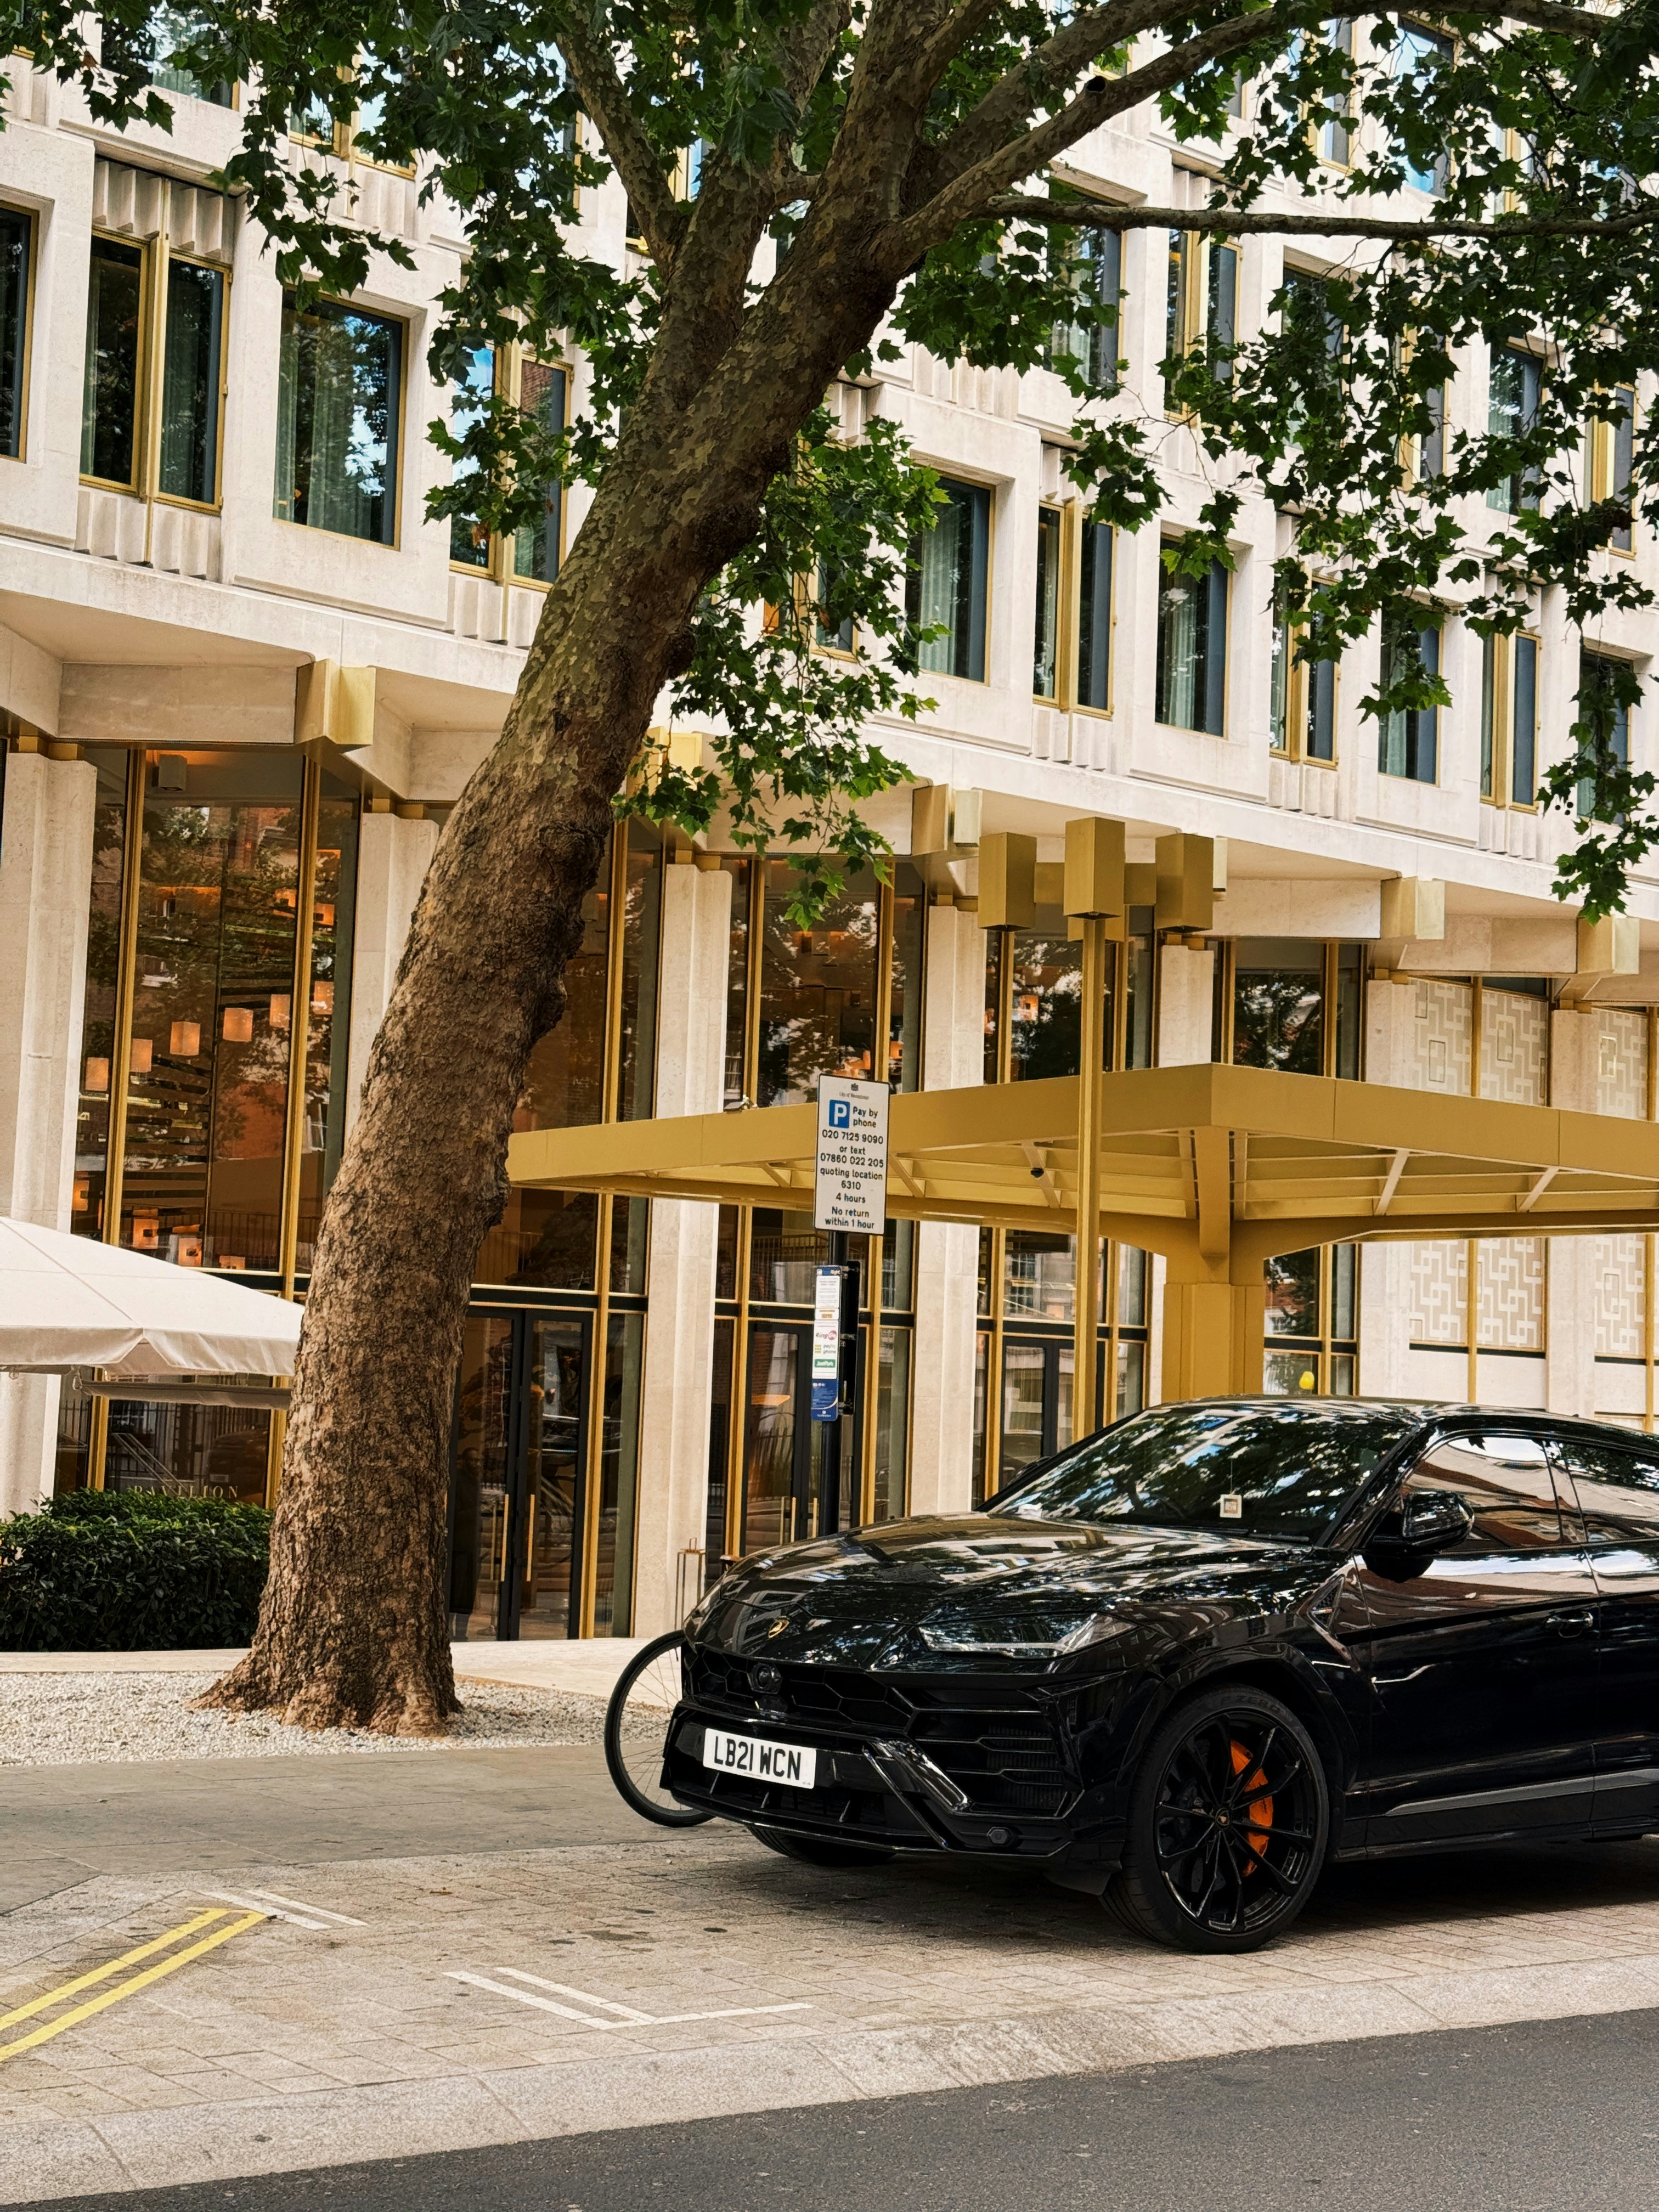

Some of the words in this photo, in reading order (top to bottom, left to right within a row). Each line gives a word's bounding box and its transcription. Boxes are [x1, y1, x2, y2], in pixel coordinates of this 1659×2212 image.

[834, 1103, 847, 1125] P
[853, 1106, 867, 1117] Pay
[869, 1108, 878, 1119] by
[853, 1117, 877, 1128] phone
[822, 1129, 839, 1139] 020
[841, 1131, 860, 1142] 7125
[861, 1134, 884, 1144] 9090
[850, 1145, 866, 1155] text
[820, 1152, 847, 1164] 07860
[849, 1155, 866, 1166] 022
[867, 1158, 884, 1168] 205
[820, 1167, 850, 1178] quoting
[851, 1169, 883, 1181] location
[840, 1180, 861, 1190] 6310
[836, 1192, 842, 1201] 4
[844, 1193, 866, 1204] hours
[831, 1206, 843, 1216] No
[845, 1208, 870, 1218] return
[825, 1217, 849, 1227] within
[851, 1219, 855, 1227] 1
[857, 1220, 874, 1229] hour
[134, 1485, 239, 1499] PAVILION
[714, 1735, 754, 1771] LB21
[759, 1745, 802, 1781] WCN
